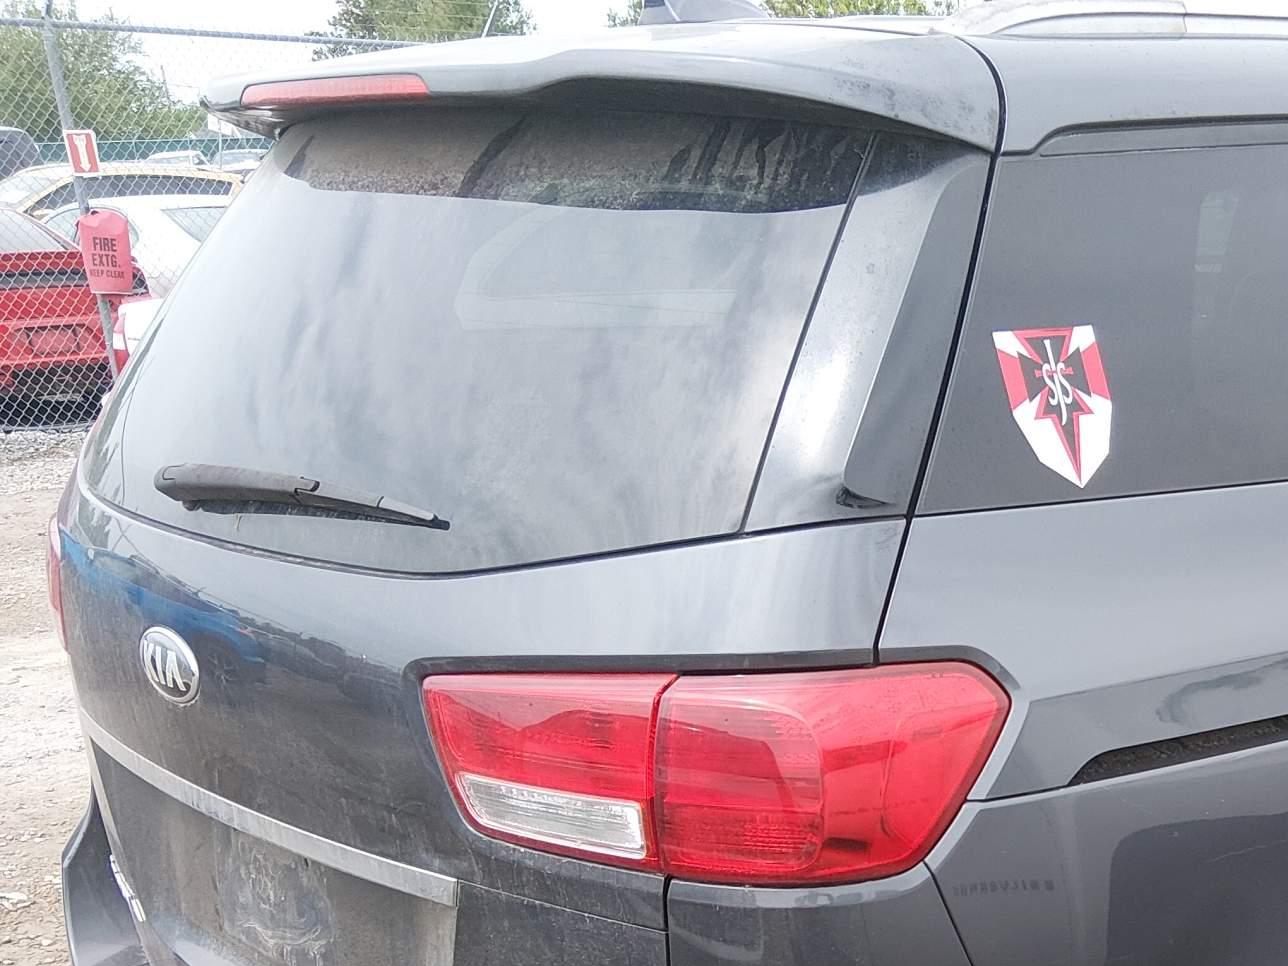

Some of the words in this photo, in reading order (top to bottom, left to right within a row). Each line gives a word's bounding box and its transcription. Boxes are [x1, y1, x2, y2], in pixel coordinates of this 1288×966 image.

[92, 236, 118, 252] FIRE
[91, 253, 122, 268] EXTG.
[143, 639, 187, 692] KIA
